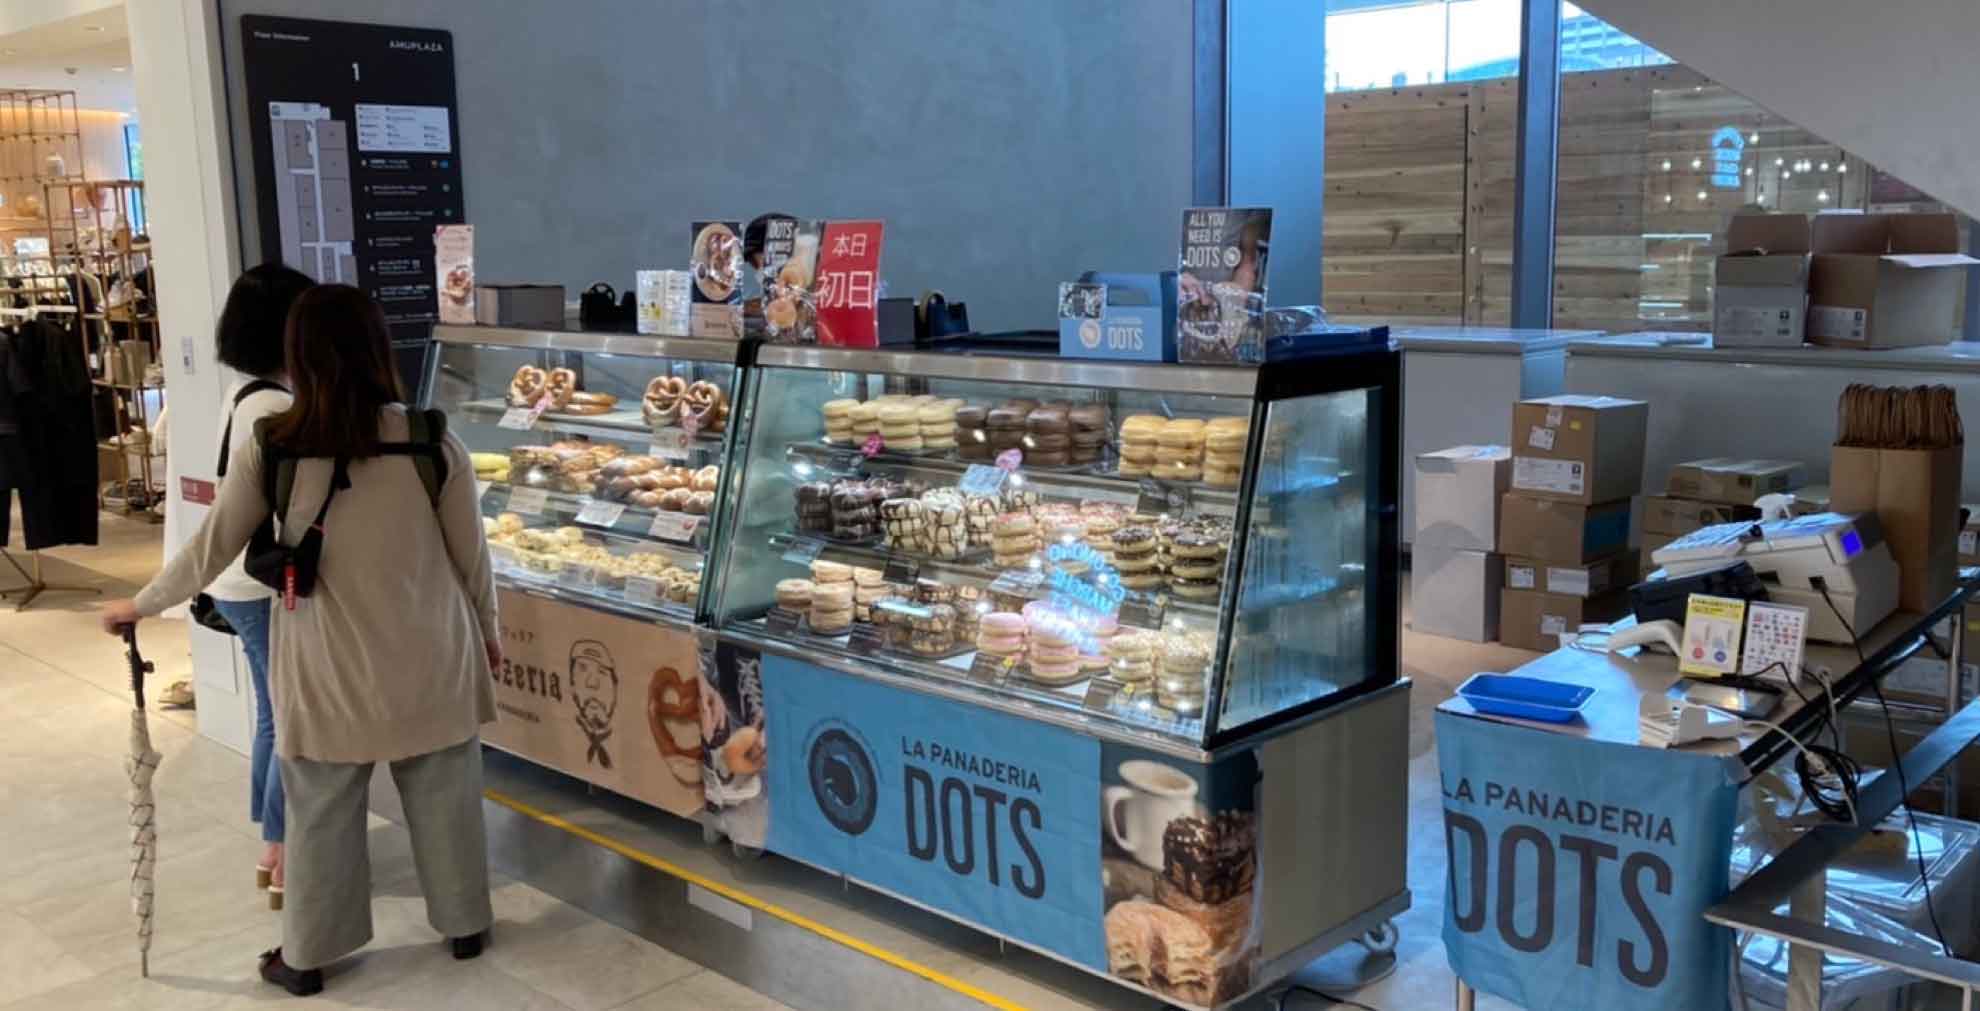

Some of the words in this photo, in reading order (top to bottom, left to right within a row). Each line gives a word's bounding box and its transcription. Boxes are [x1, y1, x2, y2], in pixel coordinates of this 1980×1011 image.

[352, 62, 360, 81] 1
[1189, 213, 1206, 227] ALL
[1207, 212, 1226, 227] YOU
[832, 233, 868, 257] 本日
[1188, 229, 1210, 243] NEED
[1212, 229, 1223, 242] IS
[1186, 247, 1221, 268] DOTS
[817, 270, 873, 310] 初日
[1107, 327, 1145, 350] DOTS
[902, 735, 925, 760] LA
[930, 743, 1041, 793] PANADERIA
[1441, 772, 1475, 803] LA
[1485, 781, 1676, 846] PANADERIA
[903, 763, 1046, 900] DOTS
[1444, 807, 1673, 988] DOTS
